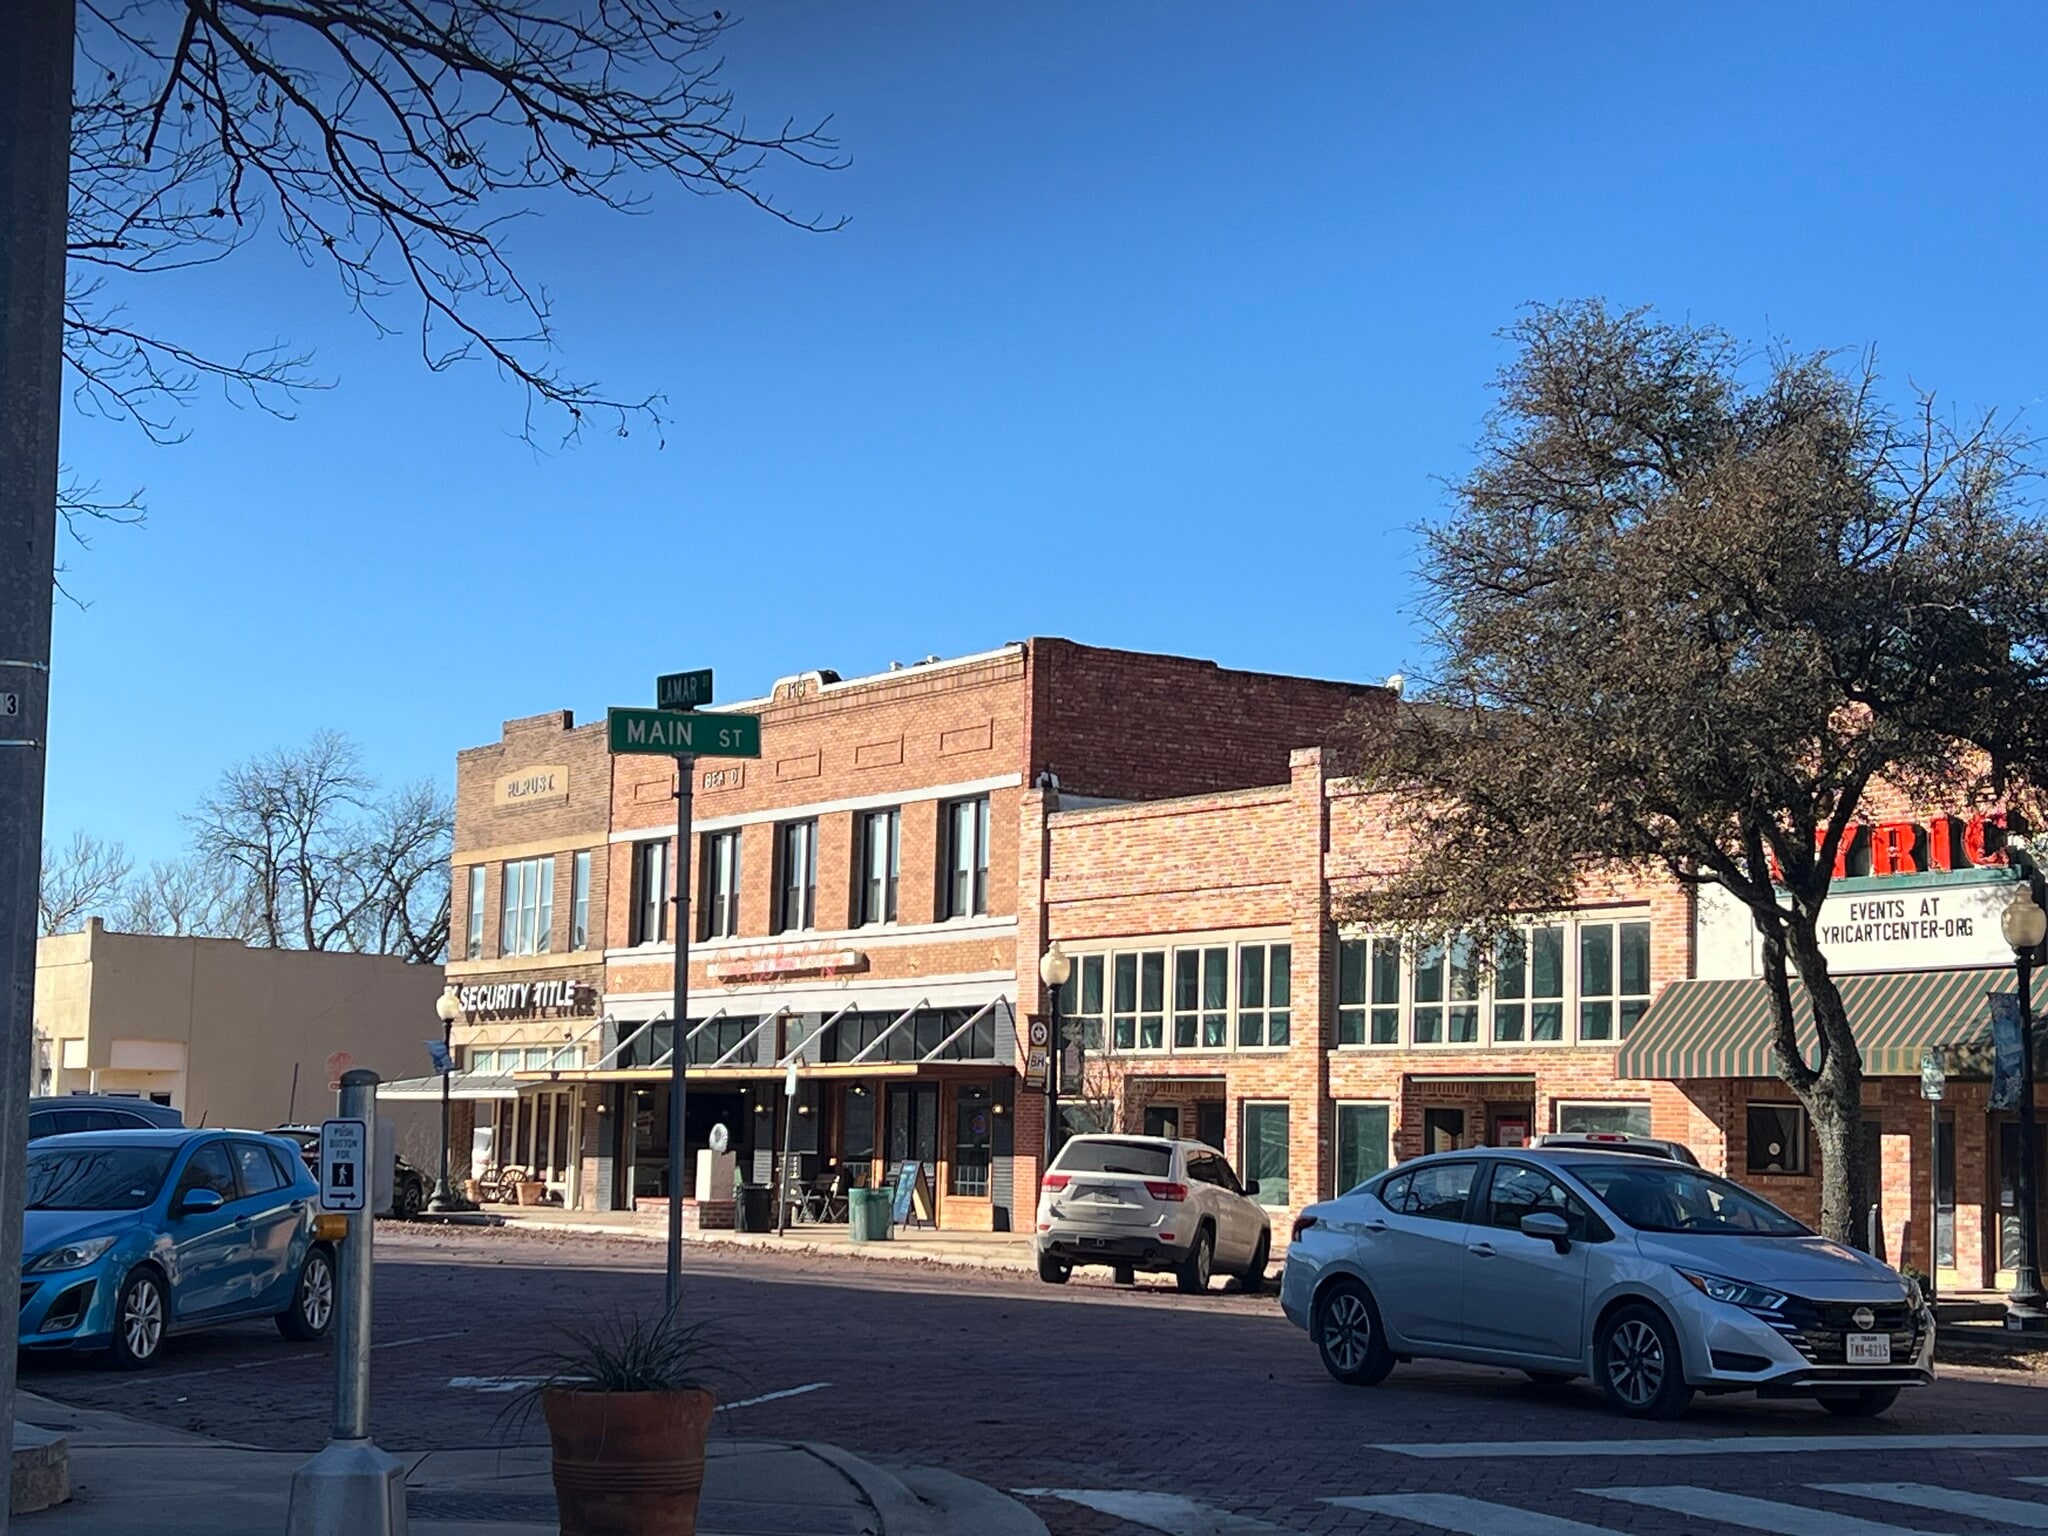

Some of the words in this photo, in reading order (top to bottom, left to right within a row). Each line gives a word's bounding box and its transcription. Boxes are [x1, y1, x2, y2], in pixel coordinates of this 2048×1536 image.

[659, 676, 698, 705] LAMAR
[7, 694, 17, 715] 3
[627, 719, 692, 746] MAIN
[719, 729, 743, 748] ST
[1850, 900, 1905, 922] EVENTS
[1920, 897, 1941, 917] AT
[1818, 917, 1975, 944] YRICARTCENTER-ORG
[459, 982, 532, 1013] SECURITY
[533, 980, 577, 1008] TITLE
[329, 1138, 358, 1149] BUTTON
[333, 1127, 354, 1137] PUSH
[336, 1150, 351, 1160] FOR
